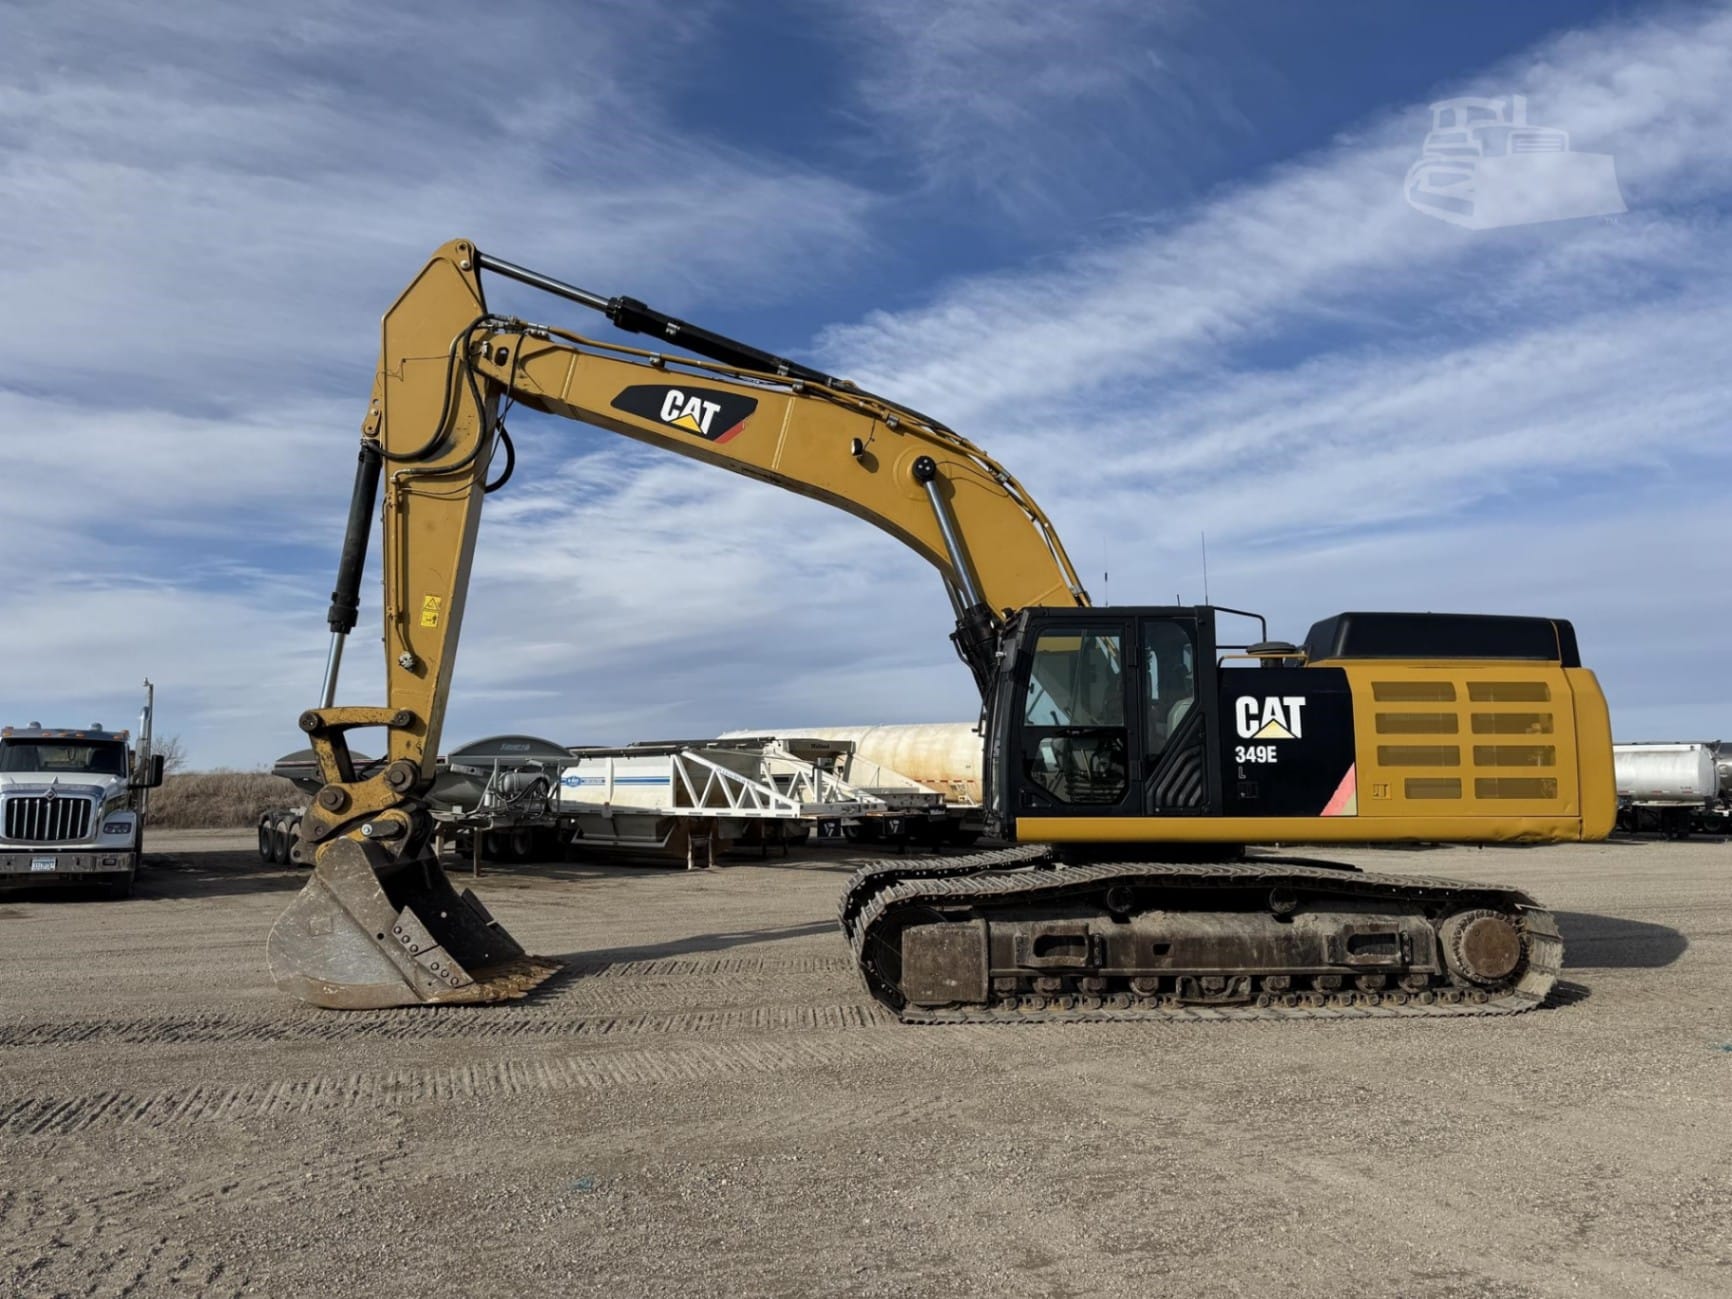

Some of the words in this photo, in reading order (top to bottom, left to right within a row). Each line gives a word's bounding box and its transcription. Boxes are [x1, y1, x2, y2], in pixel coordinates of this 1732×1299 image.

[660, 389, 721, 434] CAT
[1236, 696, 1306, 739] CAT
[1235, 745, 1277, 763] 349E
[1238, 766, 1246, 779] L
